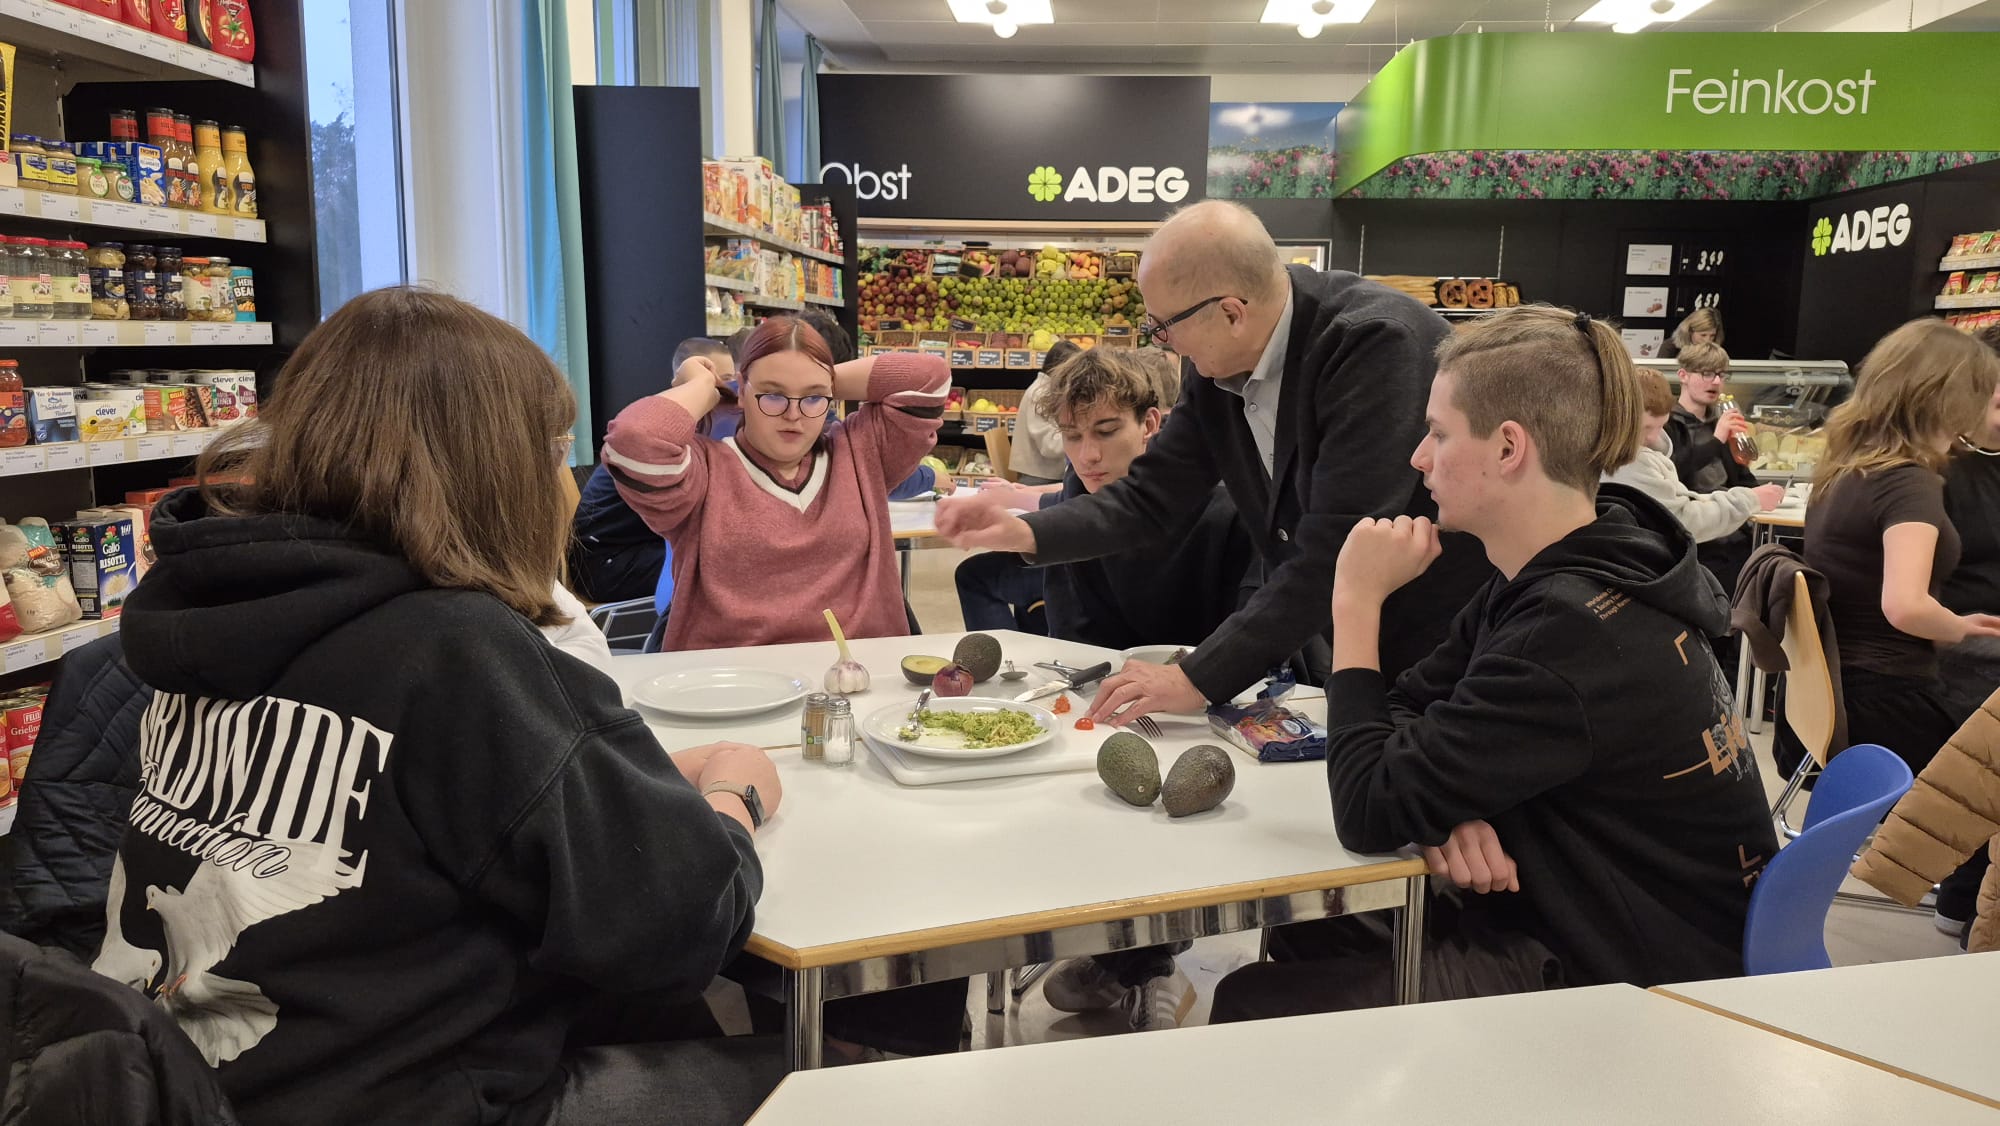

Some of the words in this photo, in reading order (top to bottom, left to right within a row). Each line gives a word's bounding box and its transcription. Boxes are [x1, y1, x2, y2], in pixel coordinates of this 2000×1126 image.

[1666, 68, 1877, 115] Feinkost
[1063, 166, 1190, 203] ADEG
[1830, 203, 1912, 254] ADEG
[1697, 250, 1724, 271] 3.49
[95, 407, 117, 416] clever
[102, 543, 121, 555] Gallo
[100, 555, 126, 569] RISOTTI
